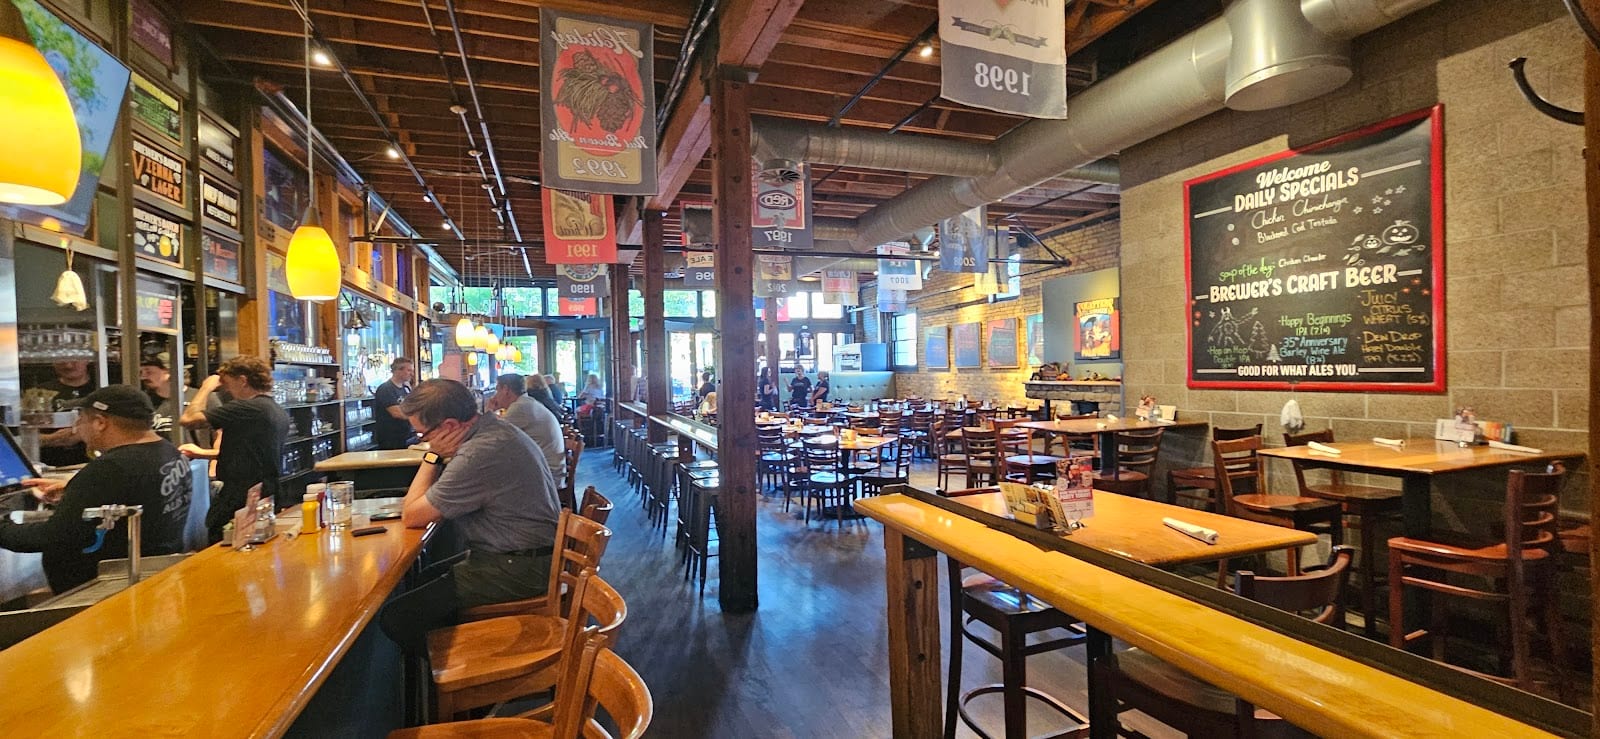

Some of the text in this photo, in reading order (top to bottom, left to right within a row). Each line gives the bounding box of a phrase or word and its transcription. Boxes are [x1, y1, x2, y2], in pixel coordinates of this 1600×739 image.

[151, 177, 181, 201] LAGER
[1256, 161, 1332, 189] Welcome
[1235, 167, 1359, 212] DAILY SPECIALS
[1210, 263, 1397, 303] BREWER'S CRAFT BEER
[1238, 364, 1359, 376] GOOD FOR WHAT ALES YOU.
